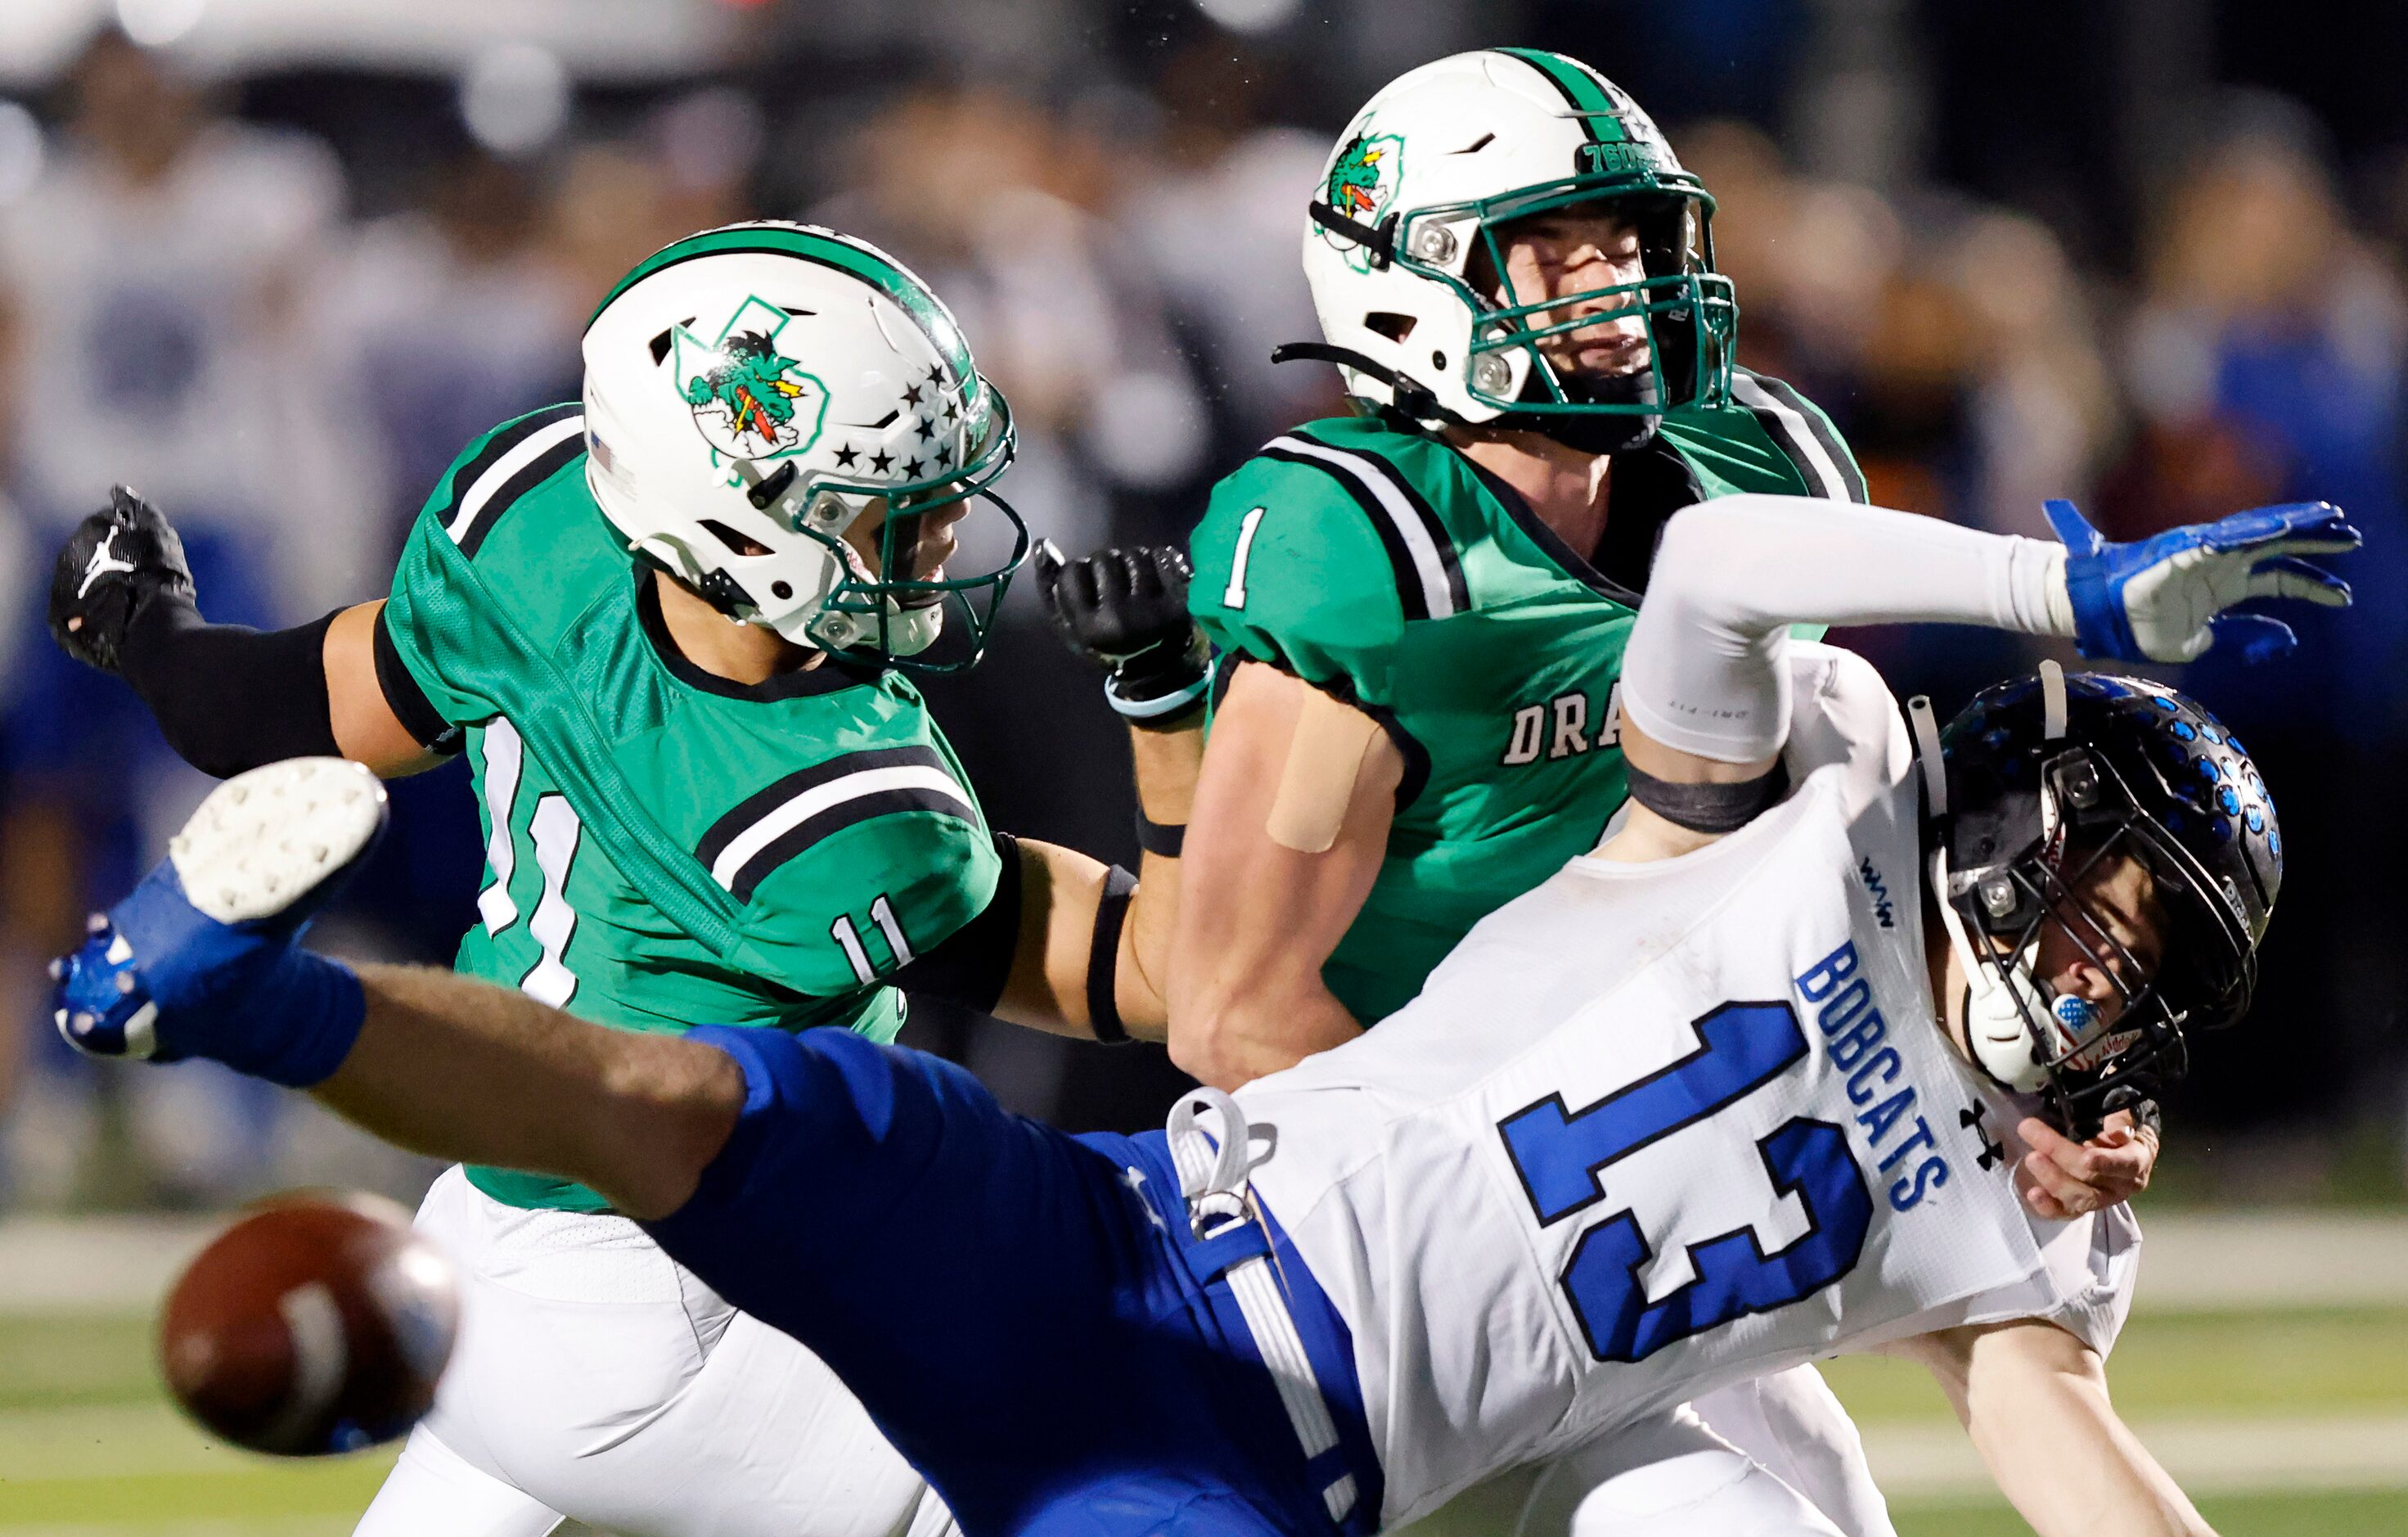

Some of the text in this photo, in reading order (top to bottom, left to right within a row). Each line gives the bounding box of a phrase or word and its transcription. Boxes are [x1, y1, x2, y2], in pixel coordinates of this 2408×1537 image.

[1222, 506, 1267, 612] 1
[477, 714, 582, 1010] 11
[829, 892, 915, 989] 11
[1497, 999, 1875, 1363] 13
[1794, 939, 1949, 1213] BOBCATS
